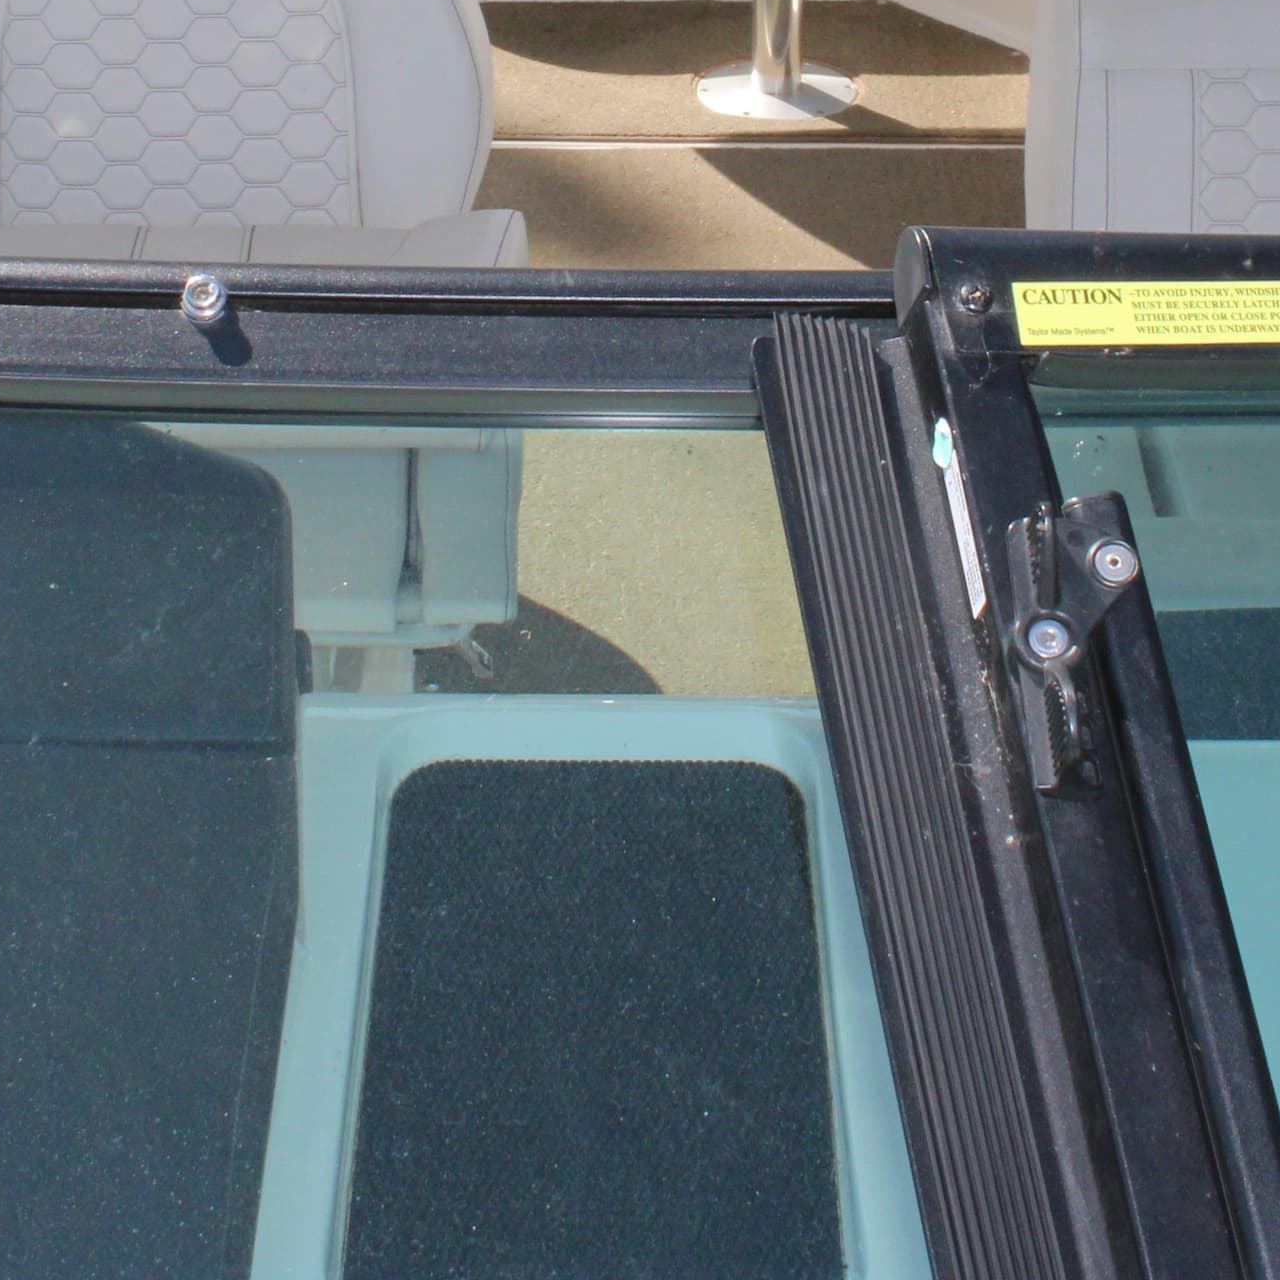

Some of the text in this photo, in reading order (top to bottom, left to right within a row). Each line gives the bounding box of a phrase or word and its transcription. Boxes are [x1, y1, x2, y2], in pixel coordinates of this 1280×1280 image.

[1022, 288, 1123, 305] CAUTION
[1153, 288, 1187, 297] AVOID
[1131, 301, 1162, 310] MUST
[1166, 301, 1180, 310] BE
[1182, 300, 1240, 309] SECURELY
[1134, 313, 1176, 322] EITHER
[1179, 313, 1209, 322] OPEN
[1212, 313, 1228, 321] OR
[1230, 312, 1268, 321] CLOSE
[1027, 327, 1047, 336] Taylor
[1051, 327, 1072, 335] Made
[1136, 325, 1171, 334] WHEN
[1173, 325, 1203, 334] BOAT
[1206, 325, 1217, 333] IS
